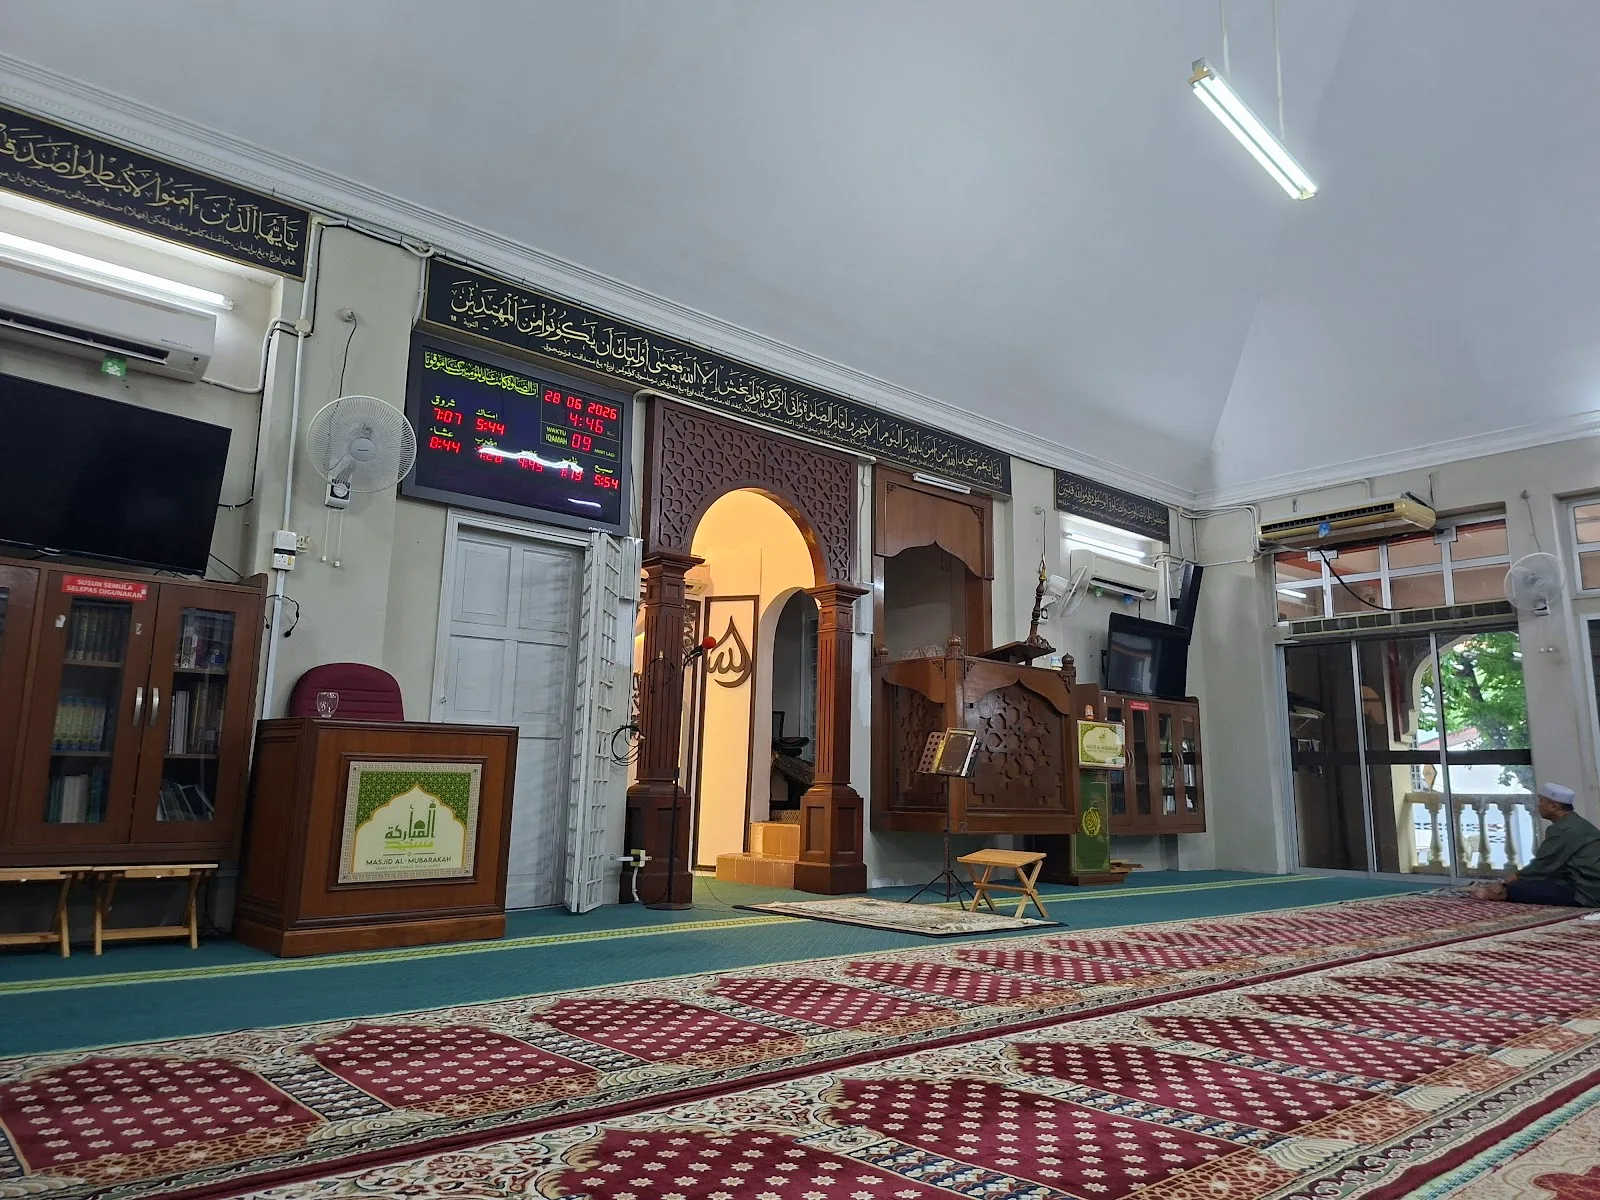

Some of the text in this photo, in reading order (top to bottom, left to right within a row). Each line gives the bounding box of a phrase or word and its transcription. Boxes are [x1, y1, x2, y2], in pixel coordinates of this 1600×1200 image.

[544, 390, 618, 420] 28 06 2026
[434, 408, 463, 424] 7:07
[569, 412, 604, 434] 4:46
[476, 418, 505, 434] 5:44
[546, 426, 566, 436] WAKTU
[429, 436, 460, 454] 8:44
[546, 434, 568, 446] IQAMAH
[572, 434, 592, 452] 09
[594, 474, 619, 489] 5:54
[66, 584, 143, 598] SELEPAS DIGUNAKAN
[76, 579, 134, 591] SUSUN SEMULA
[366, 856, 452, 866] MASJID AL-MUBARAKAH
